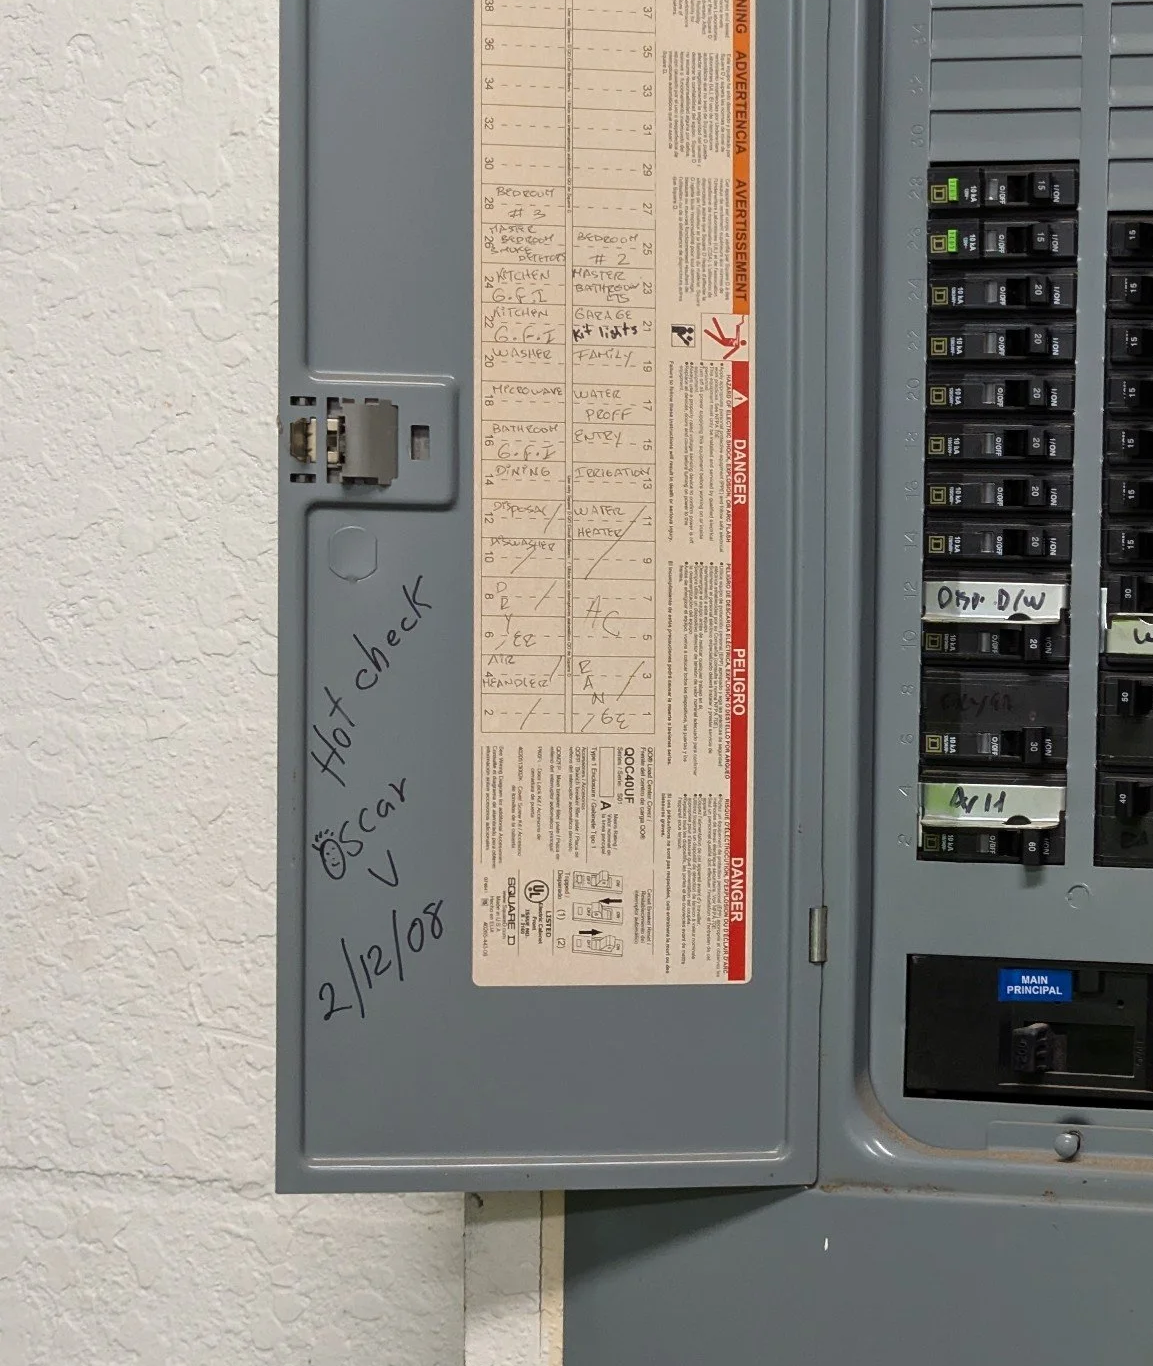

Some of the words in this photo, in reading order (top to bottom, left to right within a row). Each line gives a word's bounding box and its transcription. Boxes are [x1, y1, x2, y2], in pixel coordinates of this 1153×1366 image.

[485, 0, 493, 11] 38
[642, 6, 652, 18] 37
[485, 38, 493, 50] 36
[642, 46, 652, 58] 35
[485, 78, 493, 90] 34
[642, 85, 652, 97] 33
[735, 51, 748, 155] ADVERTENCIA
[485, 117, 493, 130] 32
[642, 125, 652, 136] 31
[485, 157, 493, 170] 30
[642, 163, 652, 176] 29
[1038, 180, 1046, 191] 15
[484, 197, 494, 209] 28
[508, 208, 522, 218] #
[534, 210, 545, 219] 3
[643, 203, 653, 215] 27
[501, 234, 553, 244] BEDROOM
[577, 232, 638, 243] BEDROOM
[1037, 233, 1044, 243] 15
[1129, 229, 1136, 240] 15
[484, 236, 494, 248] 26
[734, 179, 747, 302] AVERTISSEMENT
[643, 243, 653, 255] 25
[589, 254, 606, 264] #
[618, 254, 630, 265] 2
[572, 268, 625, 280] MASTER
[484, 276, 494, 288] 24
[643, 282, 653, 295] 23
[1035, 284, 1042, 296] 20
[1130, 283, 1137, 293] 15
[575, 308, 632, 320] GARAGE
[484, 316, 494, 328] 22
[643, 321, 653, 331] 21
[1034, 333, 1042, 344] 20
[1131, 336, 1137, 347] 15
[493, 348, 552, 359] WASHER
[484, 355, 494, 367] 20
[643, 361, 653, 372] 19
[574, 390, 620, 398] WATER
[1033, 388, 1041, 399] 20
[1129, 387, 1136, 398] 15
[484, 395, 494, 406] 18
[643, 400, 653, 411] 17
[493, 424, 558, 433] BATHROOM
[484, 435, 494, 446] 16
[574, 429, 623, 447] ENTRY
[1033, 437, 1040, 449] 20
[1127, 438, 1134, 448] 15
[643, 439, 653, 450] 15
[575, 467, 650, 478] IRRIGATION
[733, 439, 746, 505] DANGER
[484, 474, 494, 485] 14
[643, 478, 653, 489] 13
[1032, 486, 1039, 497] 20
[1128, 489, 1135, 499] 15
[574, 505, 625, 515] WATER
[484, 512, 494, 524] 12
[643, 516, 652, 526] 11
[577, 528, 623, 537] HEATER
[1032, 536, 1039, 547] 20
[1127, 539, 1134, 549] 15
[484, 552, 494, 563] 10
[1125, 588, 1131, 598] 30
[1030, 638, 1038, 649] 20
[488, 655, 515, 665] AIR
[311, 686, 355, 786] Hot
[353, 575, 432, 691] check
[732, 648, 745, 716] PELIGRO
[1121, 692, 1129, 703] 50
[1030, 741, 1038, 752] 30
[624, 747, 634, 804] QOC40UF
[1120, 793, 1126, 804] 40
[600, 800, 611, 810] A
[312, 778, 406, 880] Oscar
[368, 849, 399, 887] V
[730, 857, 743, 922] DANGER
[507, 877, 516, 929] SQUARE
[557, 909, 566, 920] (1)
[507, 935, 516, 946] D
[557, 938, 566, 949] (2)
[319, 900, 443, 1021] 2/12/08
[1021, 976, 1048, 984] MAIN
[1007, 986, 1062, 995] PRINCIPAL
